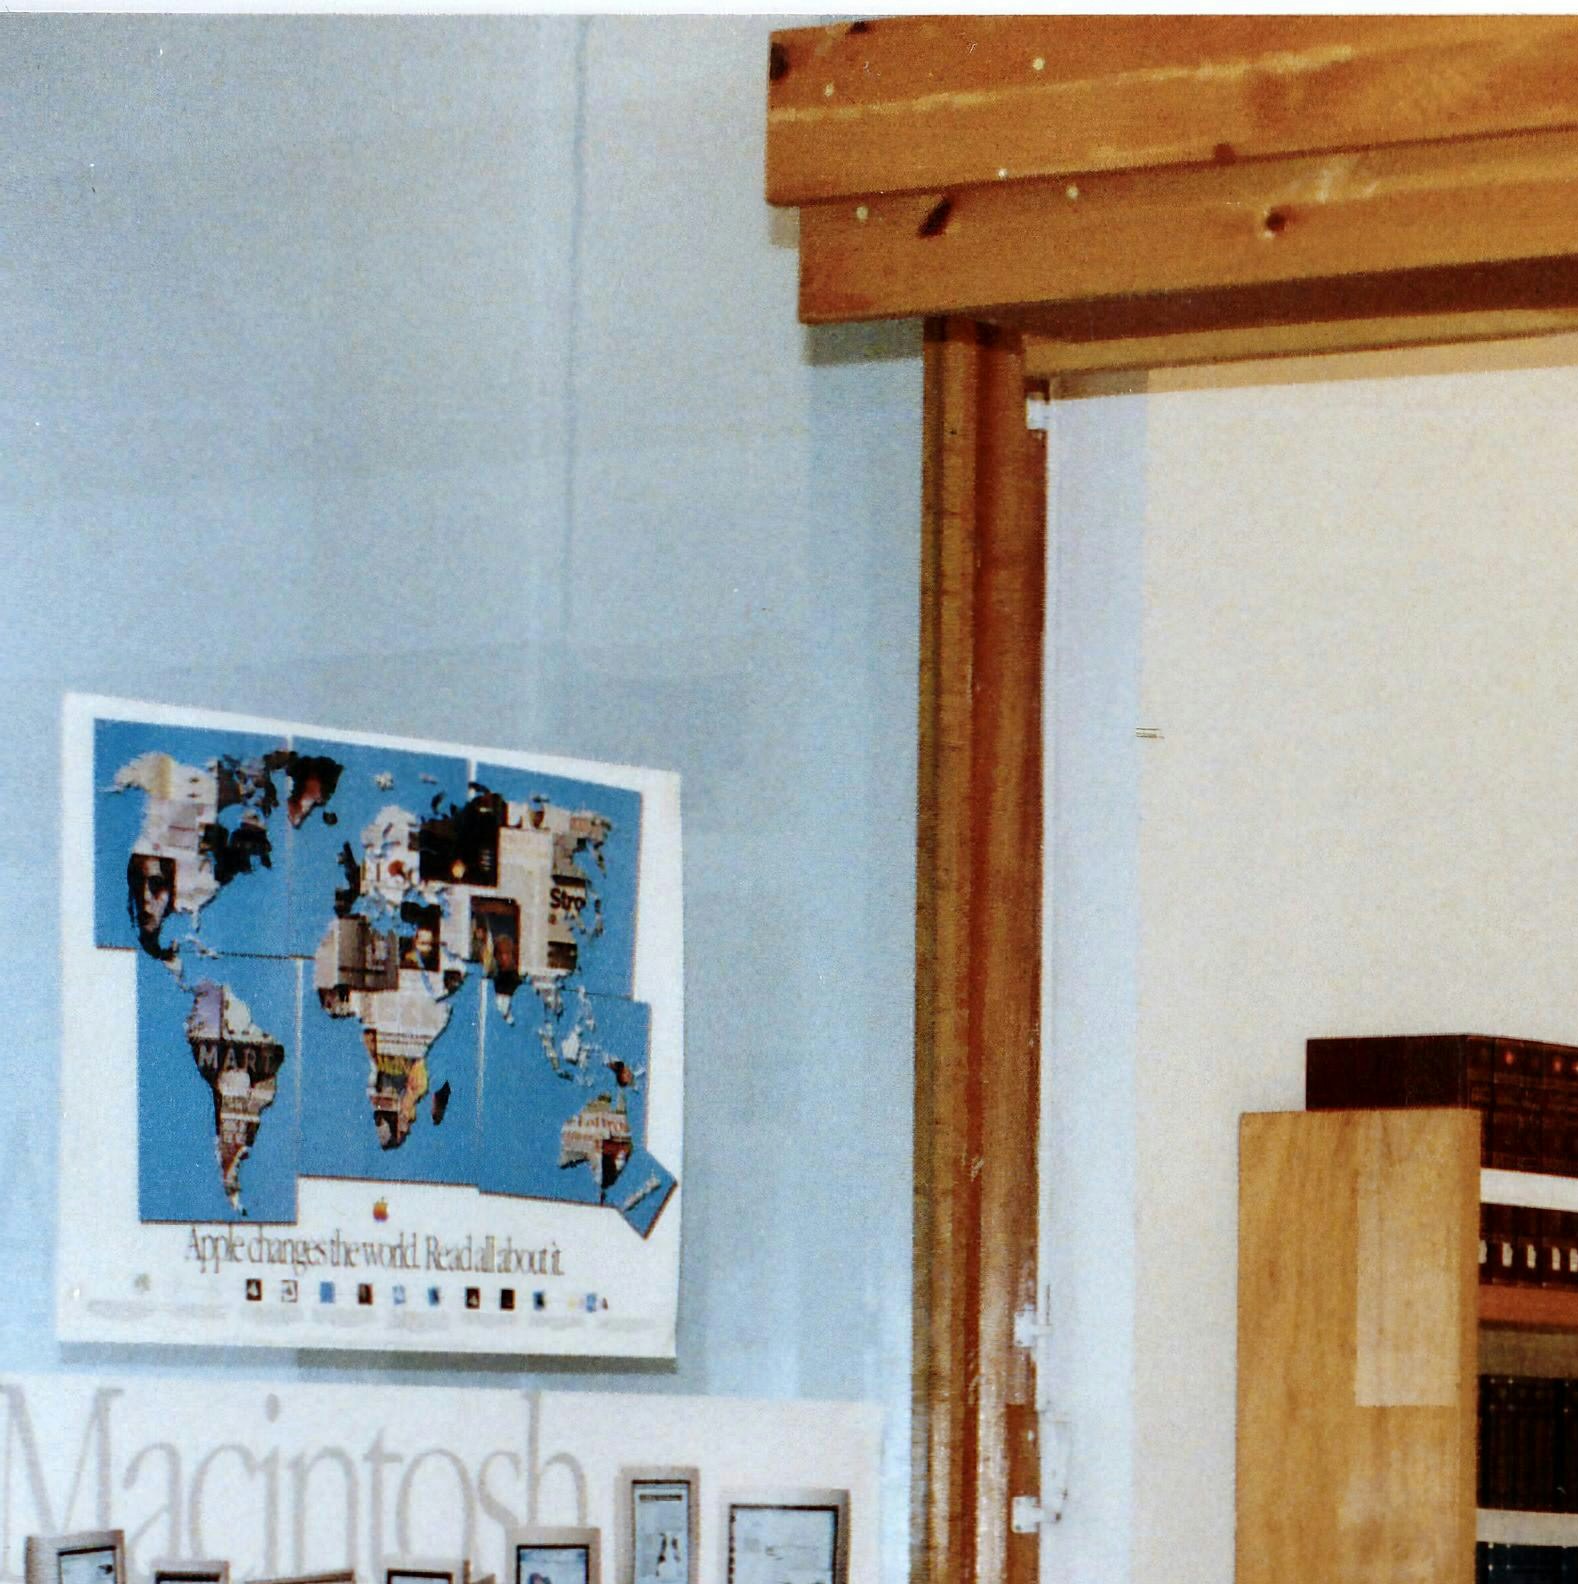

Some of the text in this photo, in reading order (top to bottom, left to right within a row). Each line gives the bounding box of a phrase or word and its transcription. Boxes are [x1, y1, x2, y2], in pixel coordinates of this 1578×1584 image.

[185, 1226, 244, 1274] Apple
[247, 1226, 326, 1276] changes
[330, 1228, 356, 1268] the
[425, 1233, 473, 1272] Read
[474, 1235, 496, 1274] all
[497, 1235, 548, 1275] about
